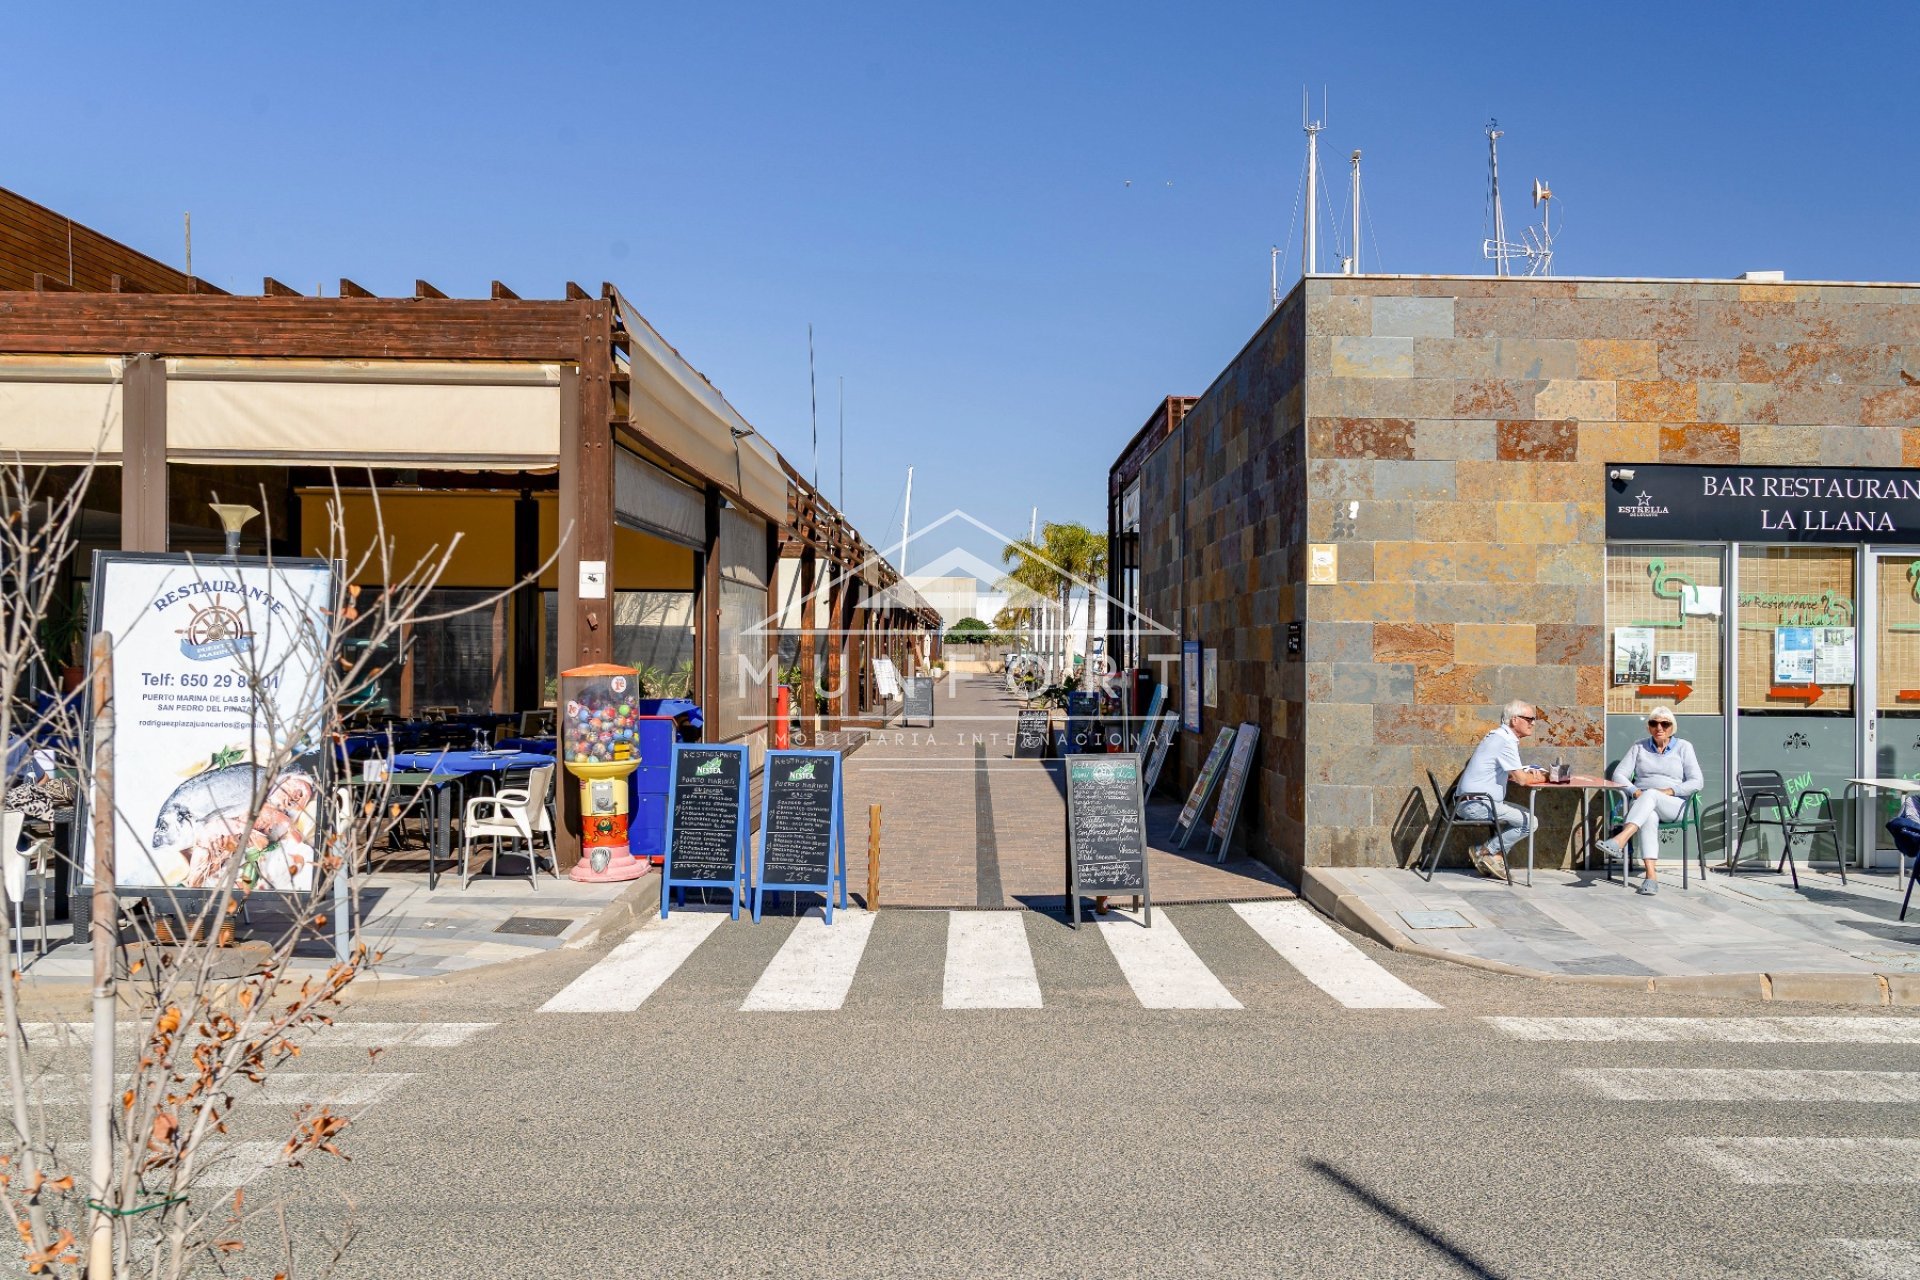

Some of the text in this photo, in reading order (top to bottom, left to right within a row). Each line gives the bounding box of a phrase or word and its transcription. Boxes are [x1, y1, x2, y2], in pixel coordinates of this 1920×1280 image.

[1702, 475, 1920, 500] BAR RESTAURAN
[1618, 506, 1669, 514] ESTRELLA
[1761, 509, 1896, 532] LA LLANA
[154, 581, 284, 615] RESTAURANTE
[142, 673, 175, 687] Telf:
[180, 674, 208, 688] 650
[213, 675, 232, 688] 29
[142, 693, 175, 702] PUERTO
[176, 694, 208, 703] MARINA
[209, 695, 221, 703] DE
[222, 695, 239, 703] LAS
[157, 703, 174, 712] SAN
[175, 704, 204, 712] PEDRO
[206, 705, 222, 713] DEL
[697, 766, 723, 774] NESTEA
[691, 869, 717, 879] 15€
[784, 872, 811, 882] 15€
